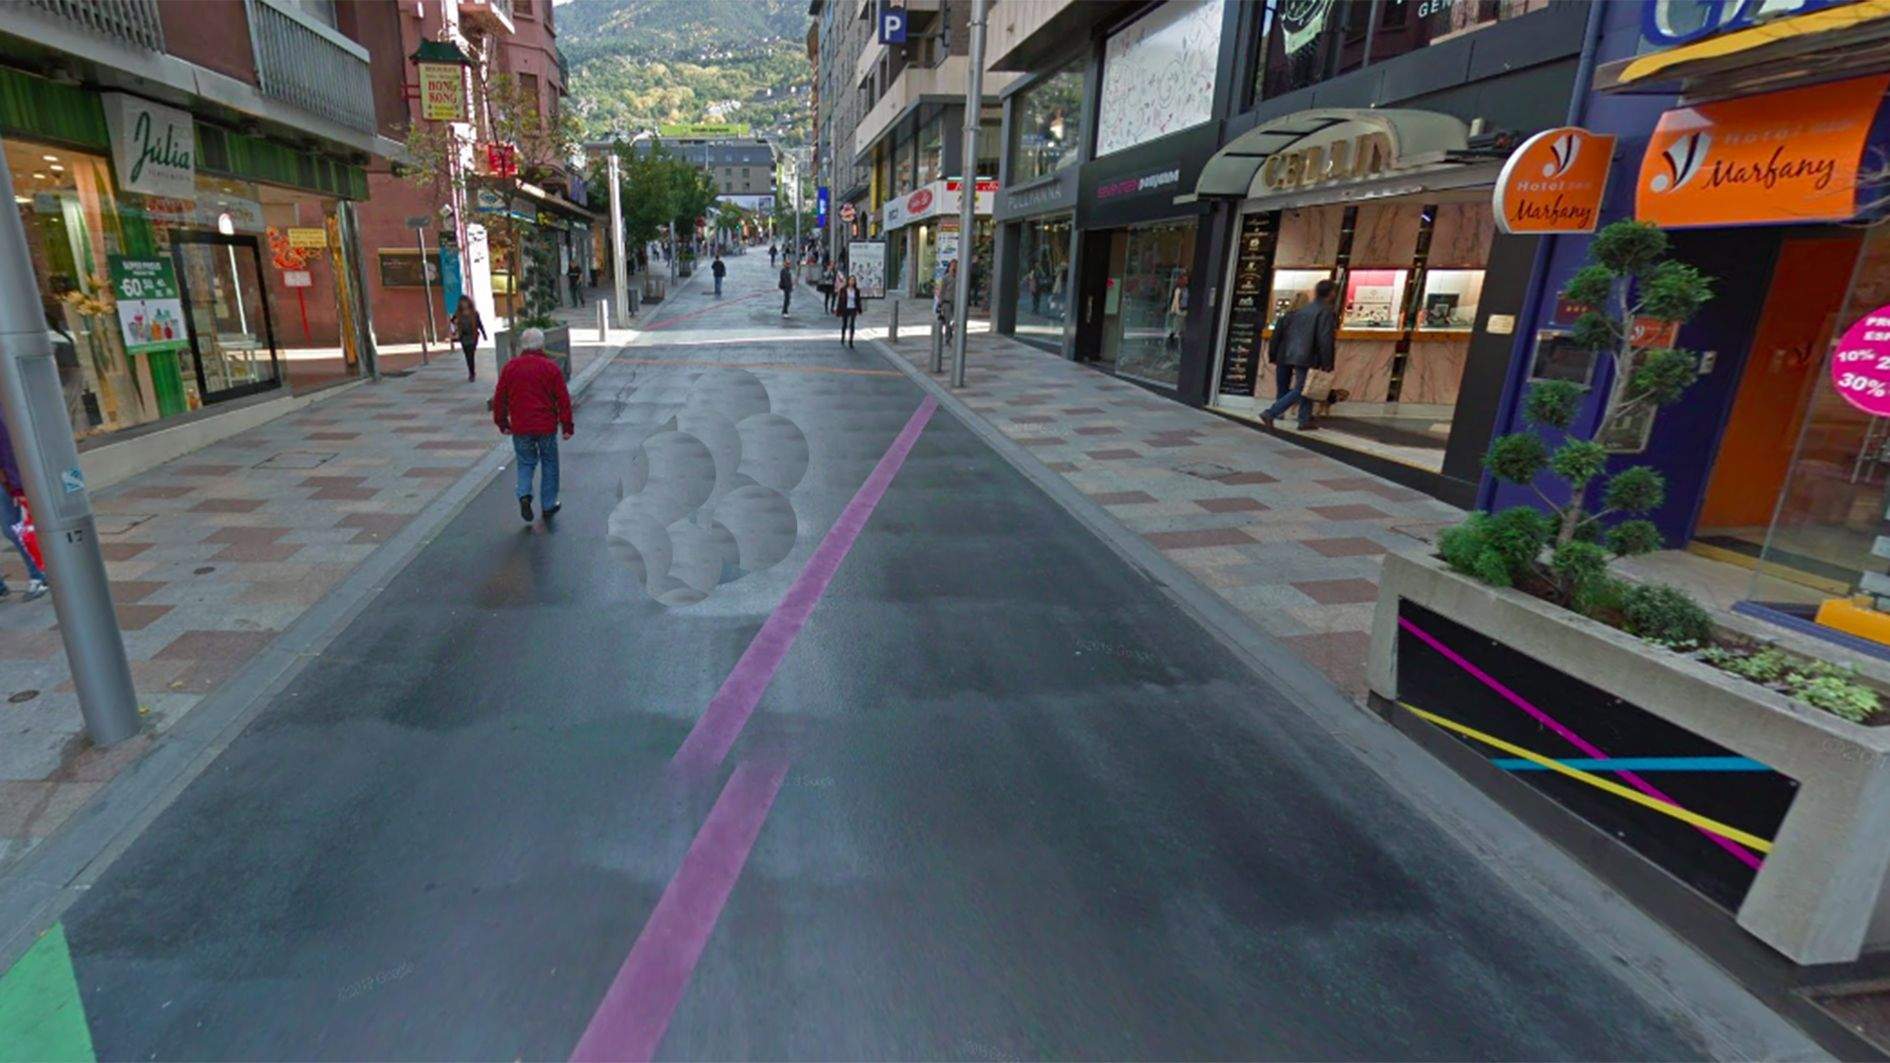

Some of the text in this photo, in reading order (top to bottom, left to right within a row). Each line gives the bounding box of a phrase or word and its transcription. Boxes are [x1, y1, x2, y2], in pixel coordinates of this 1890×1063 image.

[885, 15, 901, 40] P
[1701, 144, 1836, 190] Marfany
[1516, 181, 1565, 192] Hotel
[1509, 193, 1592, 229] Marfany
[1838, 349, 1875, 362] 10%
[1838, 372, 1885, 397] 30%
